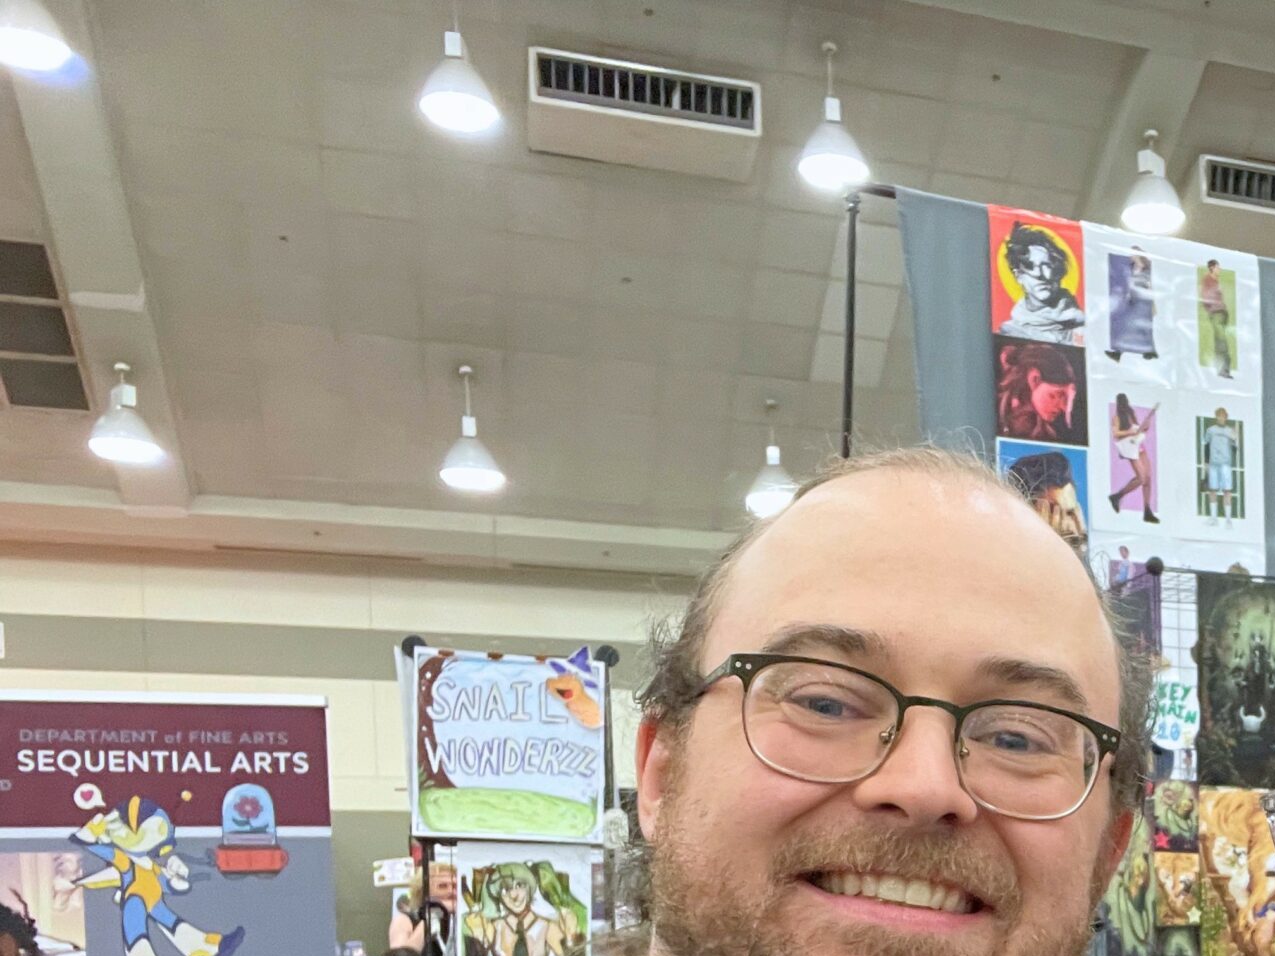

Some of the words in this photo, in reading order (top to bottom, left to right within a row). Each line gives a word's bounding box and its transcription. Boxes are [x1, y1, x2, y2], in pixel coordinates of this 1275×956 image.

[425, 676, 569, 724] SNAIL
[18, 728, 158, 744] DEPARTMENT
[164, 730, 182, 744] of
[188, 731, 233, 745] FINE
[239, 731, 289, 745] ARTS
[17, 748, 222, 777] SEQUENTIAL
[230, 750, 310, 775] ARTS
